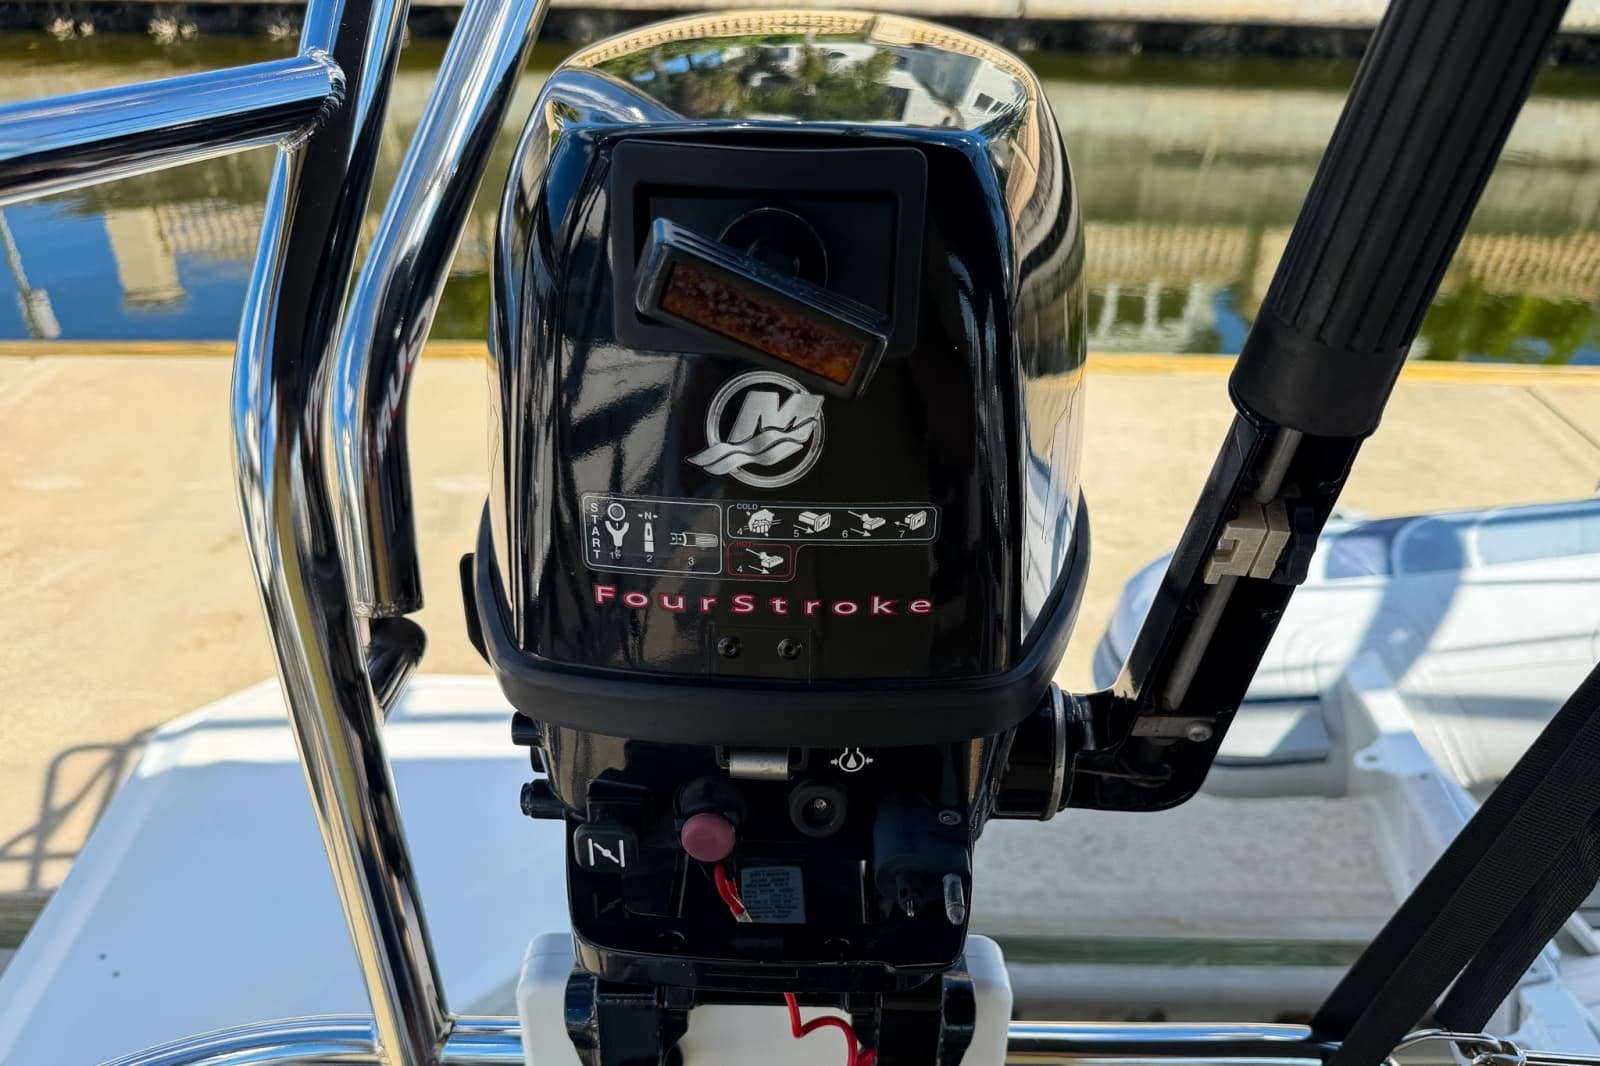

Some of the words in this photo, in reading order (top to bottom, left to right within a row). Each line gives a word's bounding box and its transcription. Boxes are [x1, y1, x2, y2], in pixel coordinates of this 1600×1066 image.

[644, 511, 652, 520] N
[590, 502, 601, 559] START
[793, 530, 800, 538] 5
[842, 530, 849, 538] 6
[899, 530, 905, 538] 7
[646, 555, 653, 563] 2
[688, 557, 695, 566] 3
[737, 565, 743, 573] 4
[594, 584, 933, 616] FourStroke
